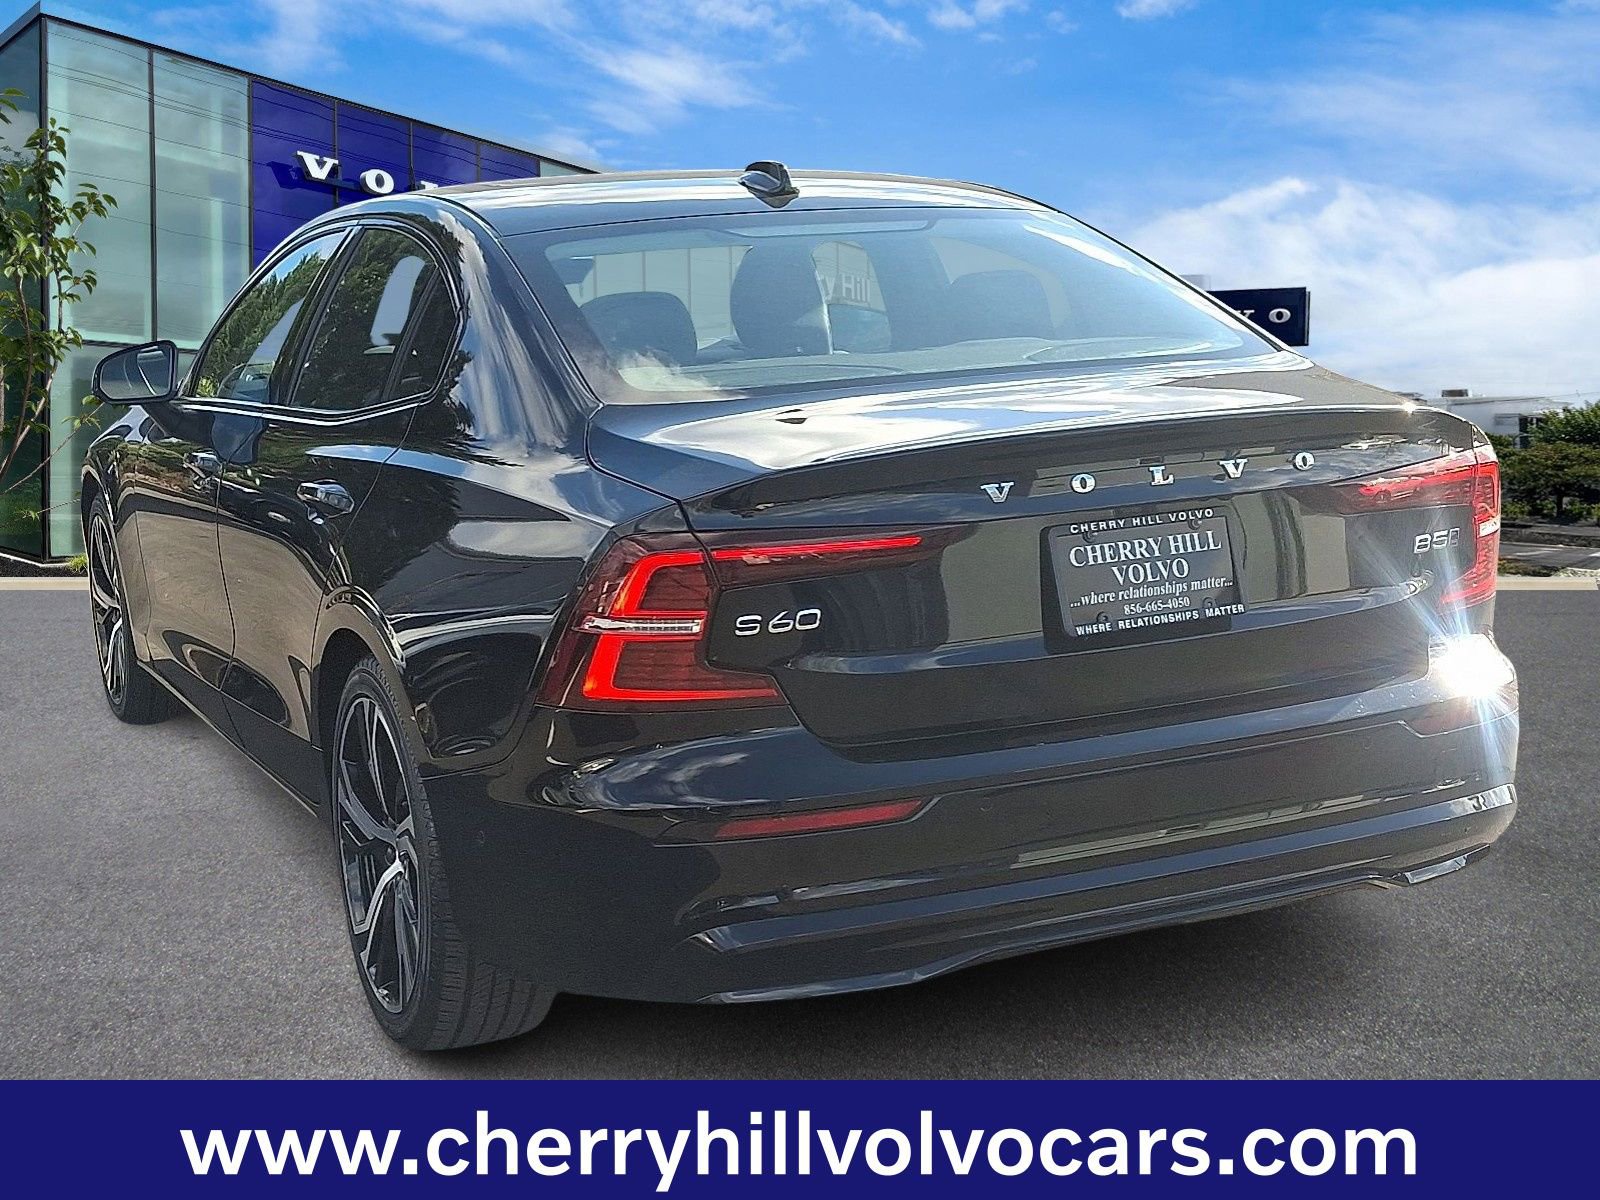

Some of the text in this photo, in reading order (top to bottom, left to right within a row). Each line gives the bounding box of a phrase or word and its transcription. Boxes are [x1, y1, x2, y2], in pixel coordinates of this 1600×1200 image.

[840, 273, 871, 302] Hill
[980, 451, 1316, 503] VOLVO
[1070, 508, 1214, 534] CHERRY HILL VOLVO
[1069, 530, 1222, 567] CHERRY HILL
[1112, 558, 1190, 586] VOLVO
[1118, 580, 1188, 601] relationships
[1076, 604, 1245, 636] WHERE RELATIONSHIPS MATTER
[1123, 597, 1190, 615] 856-665-4050
[734, 608, 822, 636] S60
